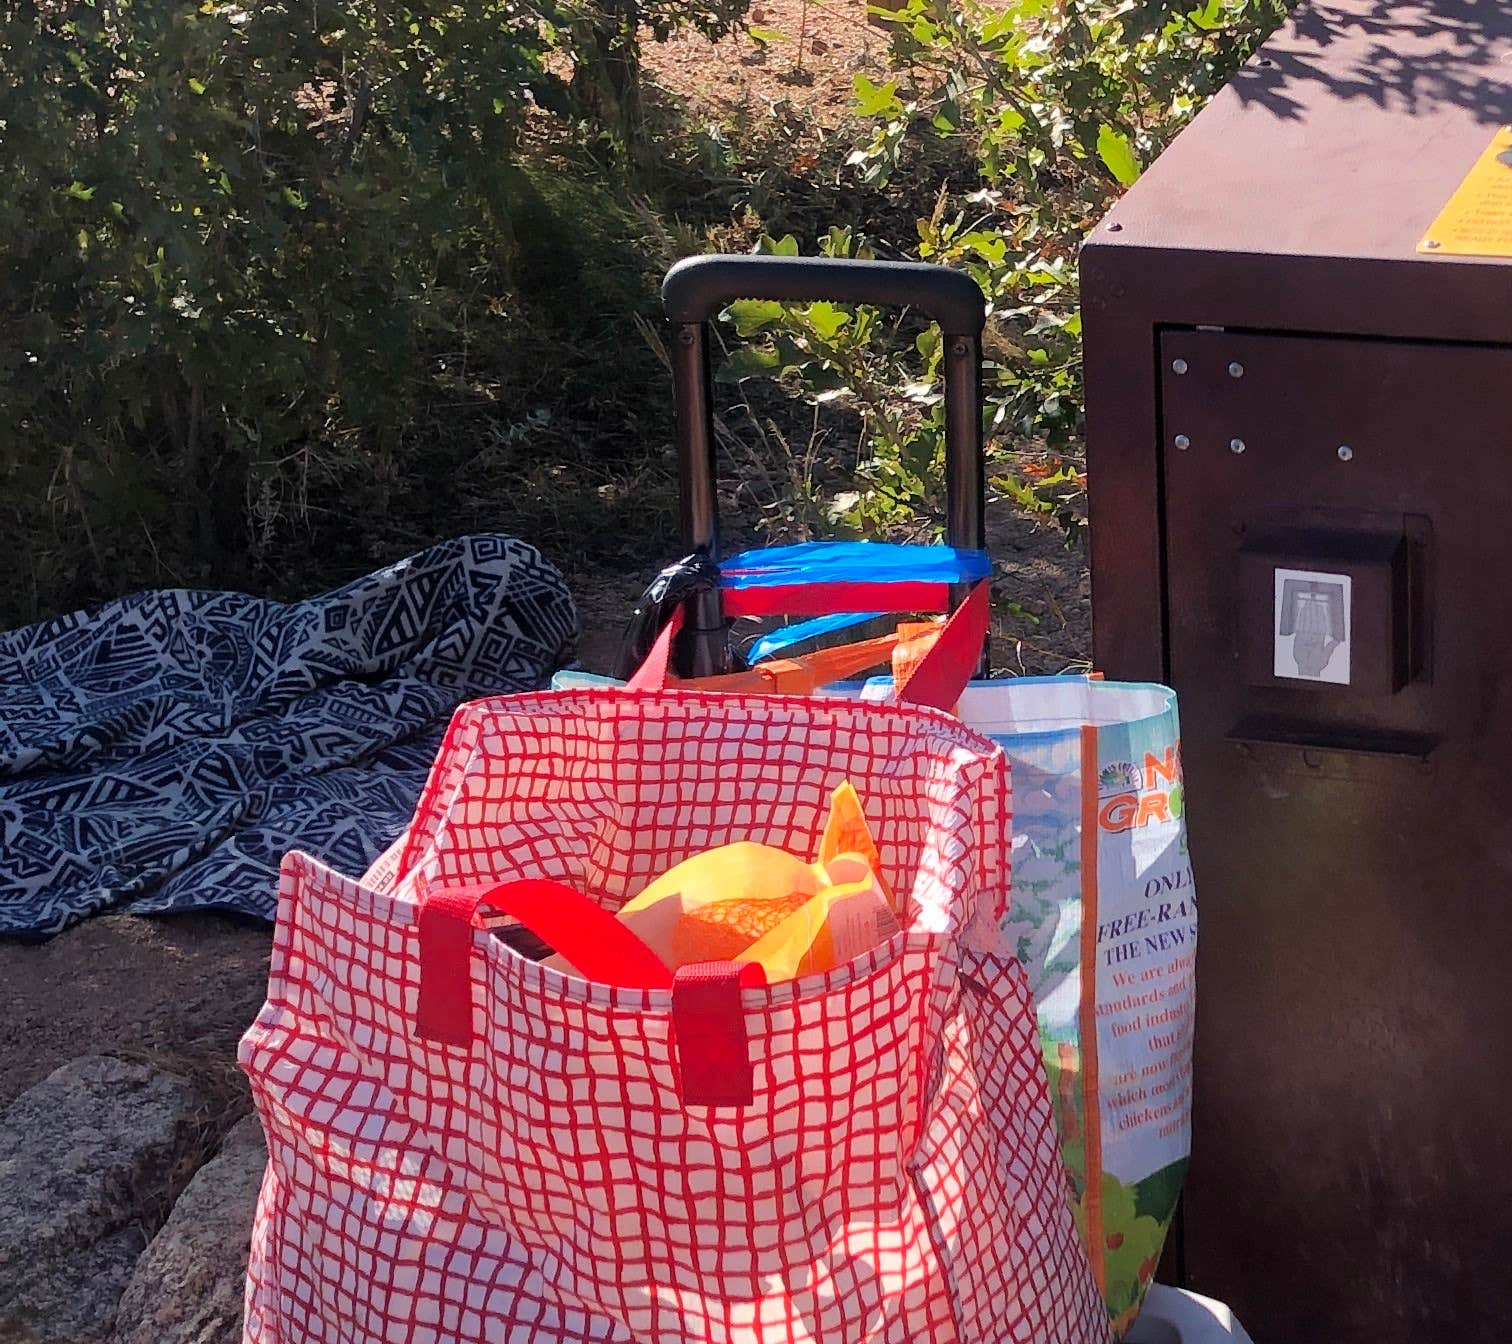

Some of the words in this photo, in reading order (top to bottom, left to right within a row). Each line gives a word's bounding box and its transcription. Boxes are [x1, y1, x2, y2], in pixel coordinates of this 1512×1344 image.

[1104, 941, 1142, 966] THE
[1144, 927, 1186, 955] NEW
[1112, 971, 1135, 988] We
[1140, 965, 1164, 982] are
